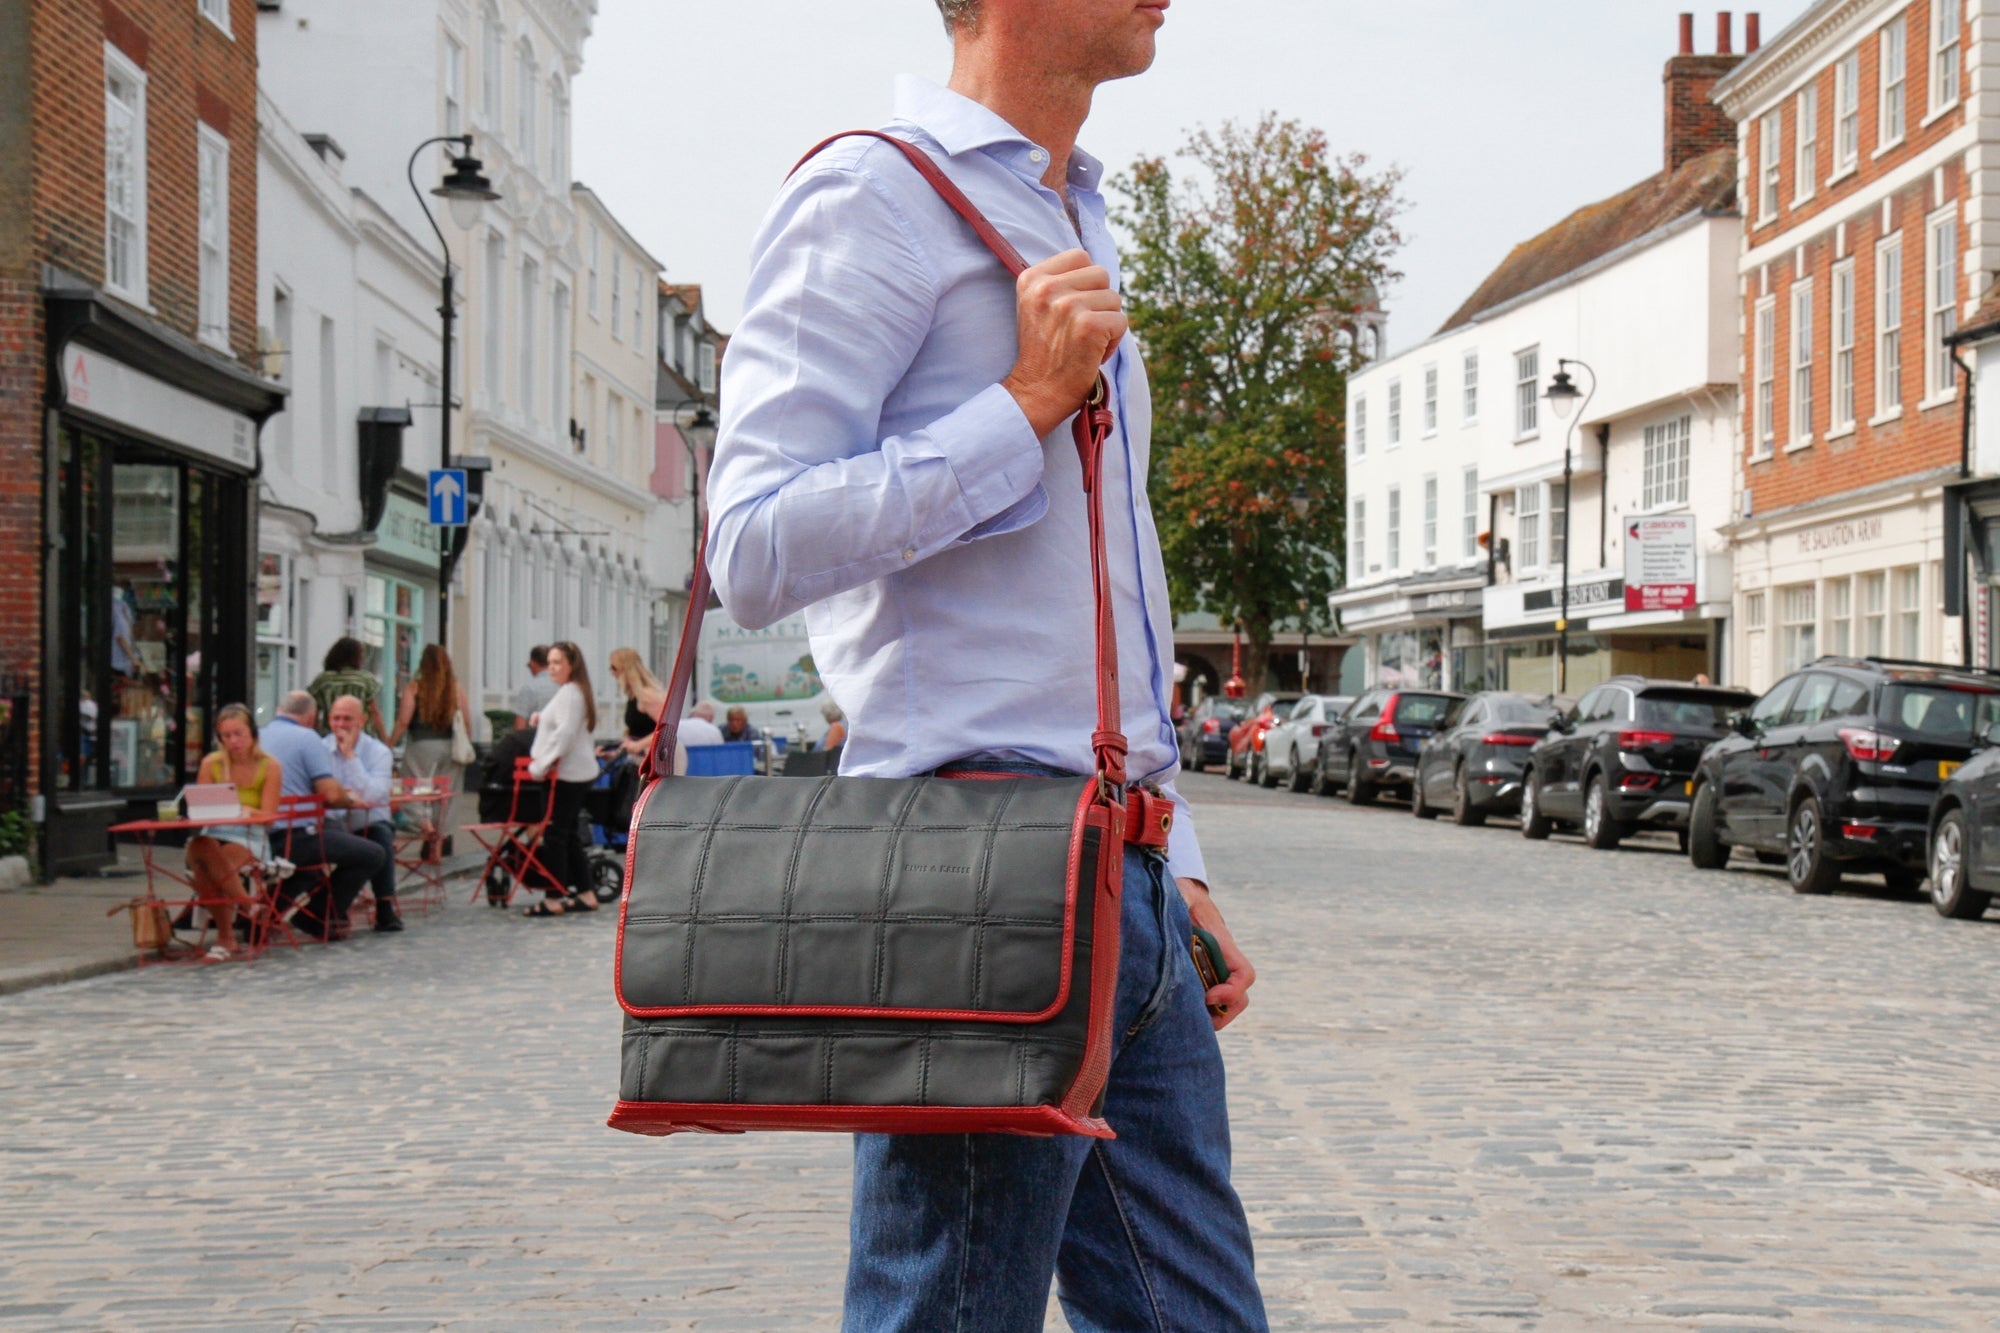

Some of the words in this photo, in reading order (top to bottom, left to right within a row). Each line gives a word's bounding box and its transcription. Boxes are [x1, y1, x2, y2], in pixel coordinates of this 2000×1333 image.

[1797, 530, 1811, 554] THE
[1813, 522, 1855, 550] SALVATION
[1858, 515, 1883, 543] ARMY
[1642, 585, 1660, 597] for
[1661, 585, 1689, 597] sale
[717, 623, 808, 638] MARKET
